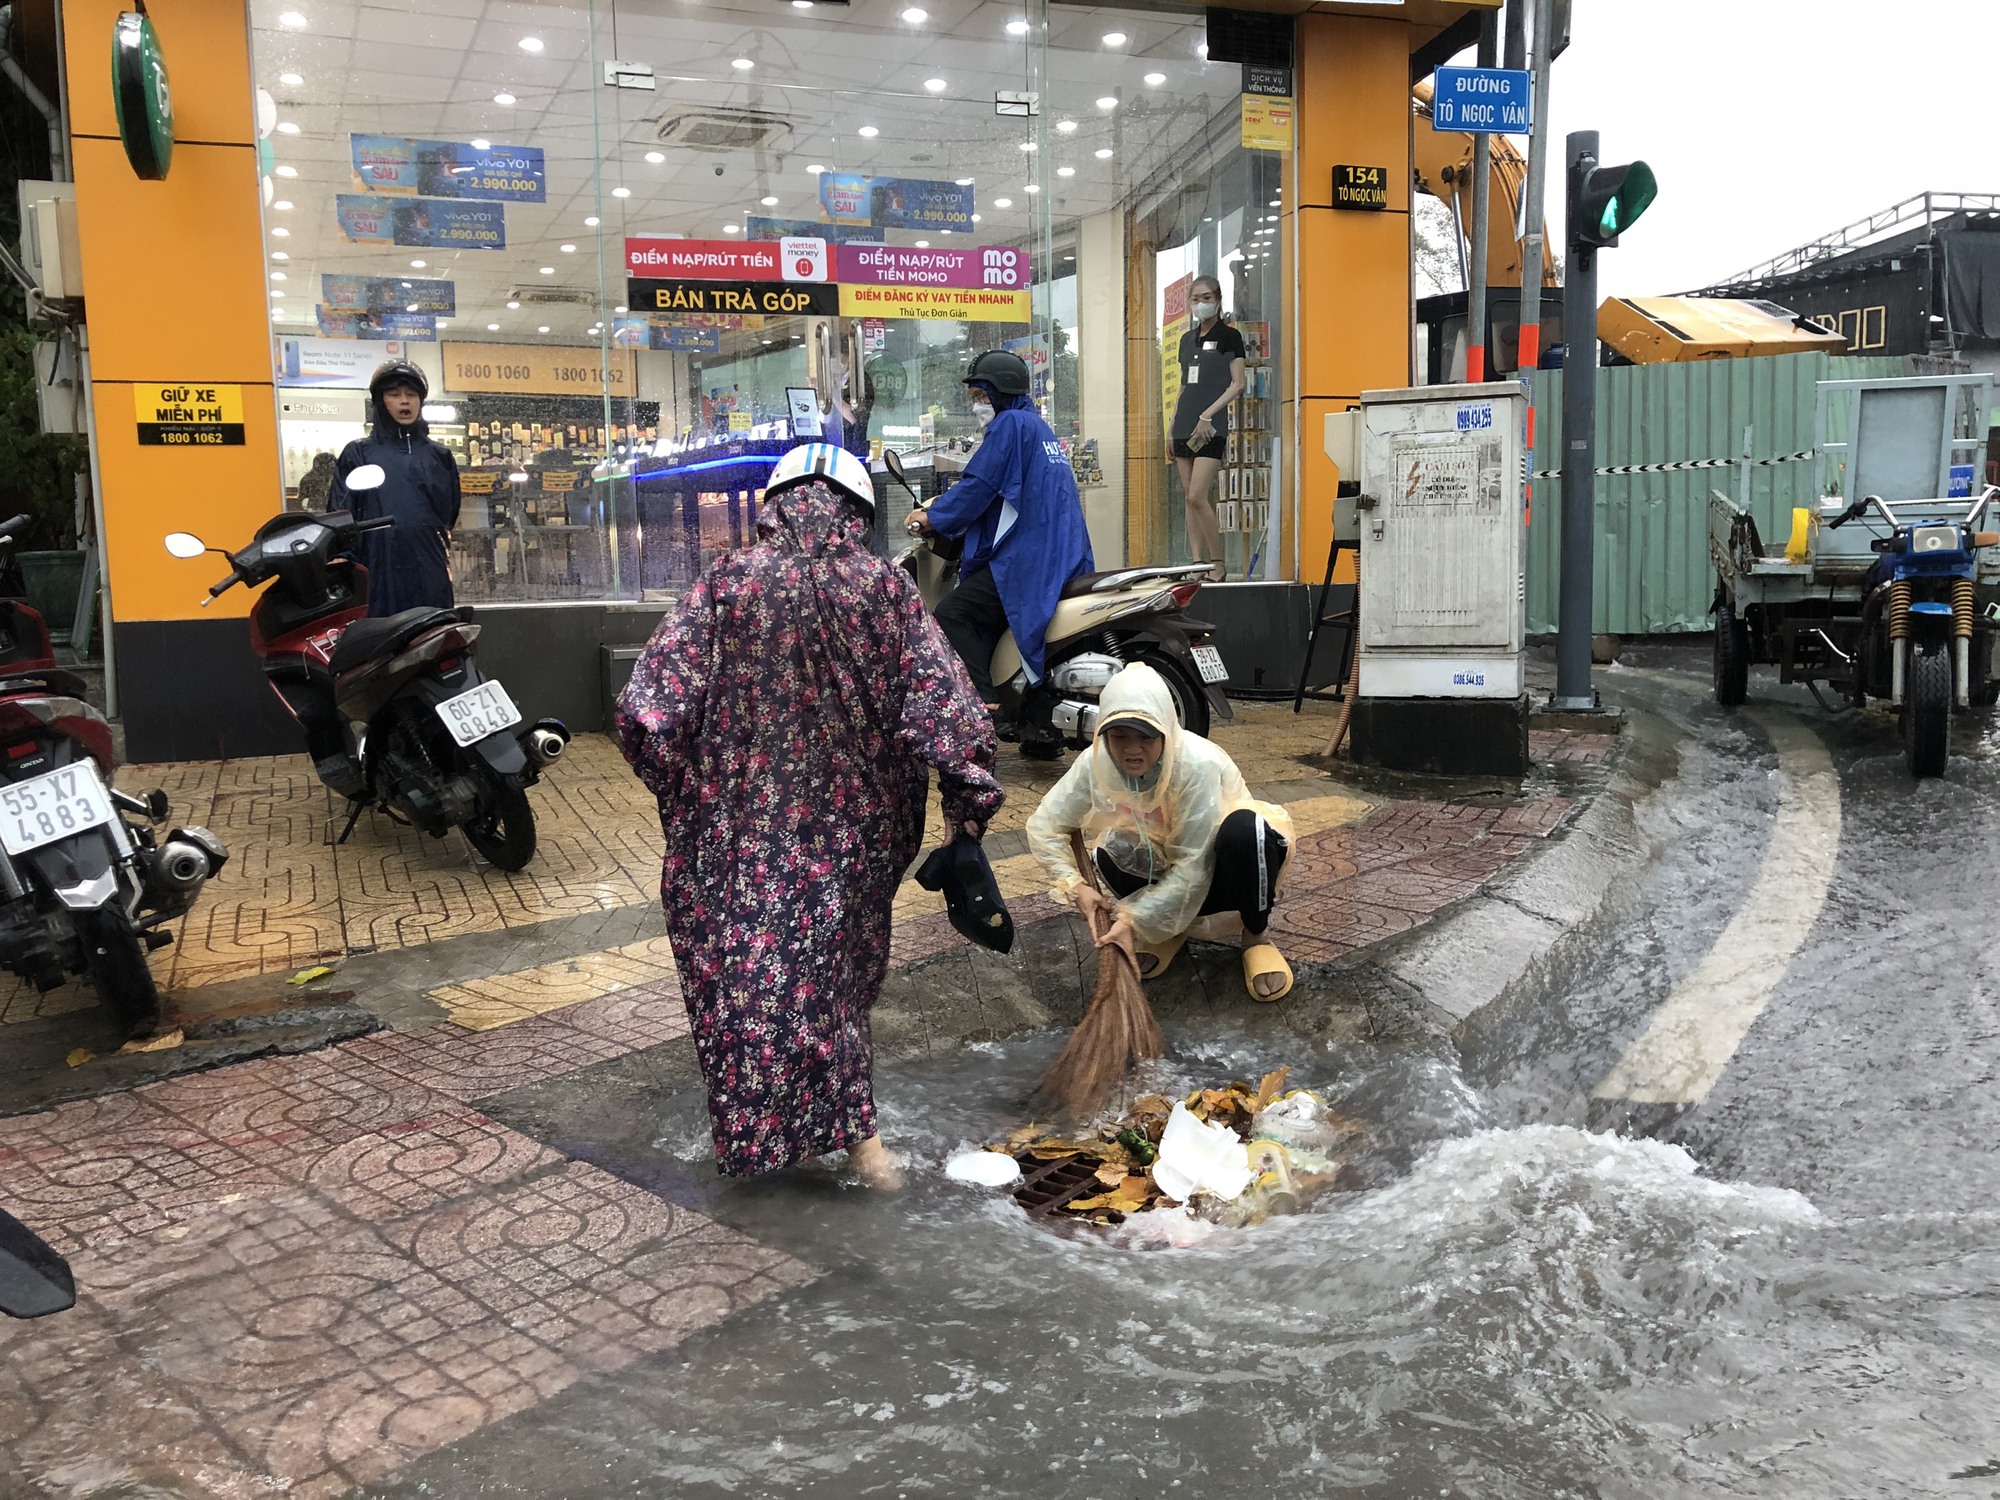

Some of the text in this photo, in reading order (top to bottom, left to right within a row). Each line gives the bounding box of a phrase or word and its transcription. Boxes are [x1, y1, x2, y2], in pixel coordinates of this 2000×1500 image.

[1251, 74, 1283, 85] DỊCH VỤ
[1456, 75, 1511, 94] ĐƯỜNG
[1263, 85, 1286, 94] THÔNG
[1439, 98, 1525, 126] TÔ NGỌC VÂN
[476, 158, 530, 169] vivo Y01
[471, 177, 537, 191] 2.990.000
[1346, 167, 1379, 185] 154
[943, 194, 962, 203] Y01
[1338, 184, 1387, 205] TÔ NGỌC VÂN
[913, 209, 967, 223] 2.990.000
[440, 229, 498, 241] 2.990.000
[787, 241, 817, 250] viettel
[787, 249, 820, 258] money
[630, 248, 774, 269] ĐIỂM NẠP/RÚT TIỀN
[858, 248, 964, 270] ĐIỂM NẠP/RÚT
[876, 266, 948, 283] TIỀN MOMO
[655, 285, 811, 312] BÁN TRẢ GÓP
[855, 287, 1014, 305] ĐIỂM ĐĂNG KÝ VAY TIỀN NHANH
[899, 307, 968, 318] Thủ Tục Đơn Giản
[303, 350, 322, 358] Redmi
[456, 363, 531, 380] 1800 1060
[553, 366, 587, 382] 1800
[161, 386, 216, 403] GIỮ XE
[156, 403, 222, 422] MIỄN PHÍ
[161, 433, 223, 443] 1800 1062
[448, 687, 498, 721] 60-Z1
[460, 705, 510, 739] 9848
[2, 770, 76, 816] 55-X7
[18, 797, 95, 842] 4883
